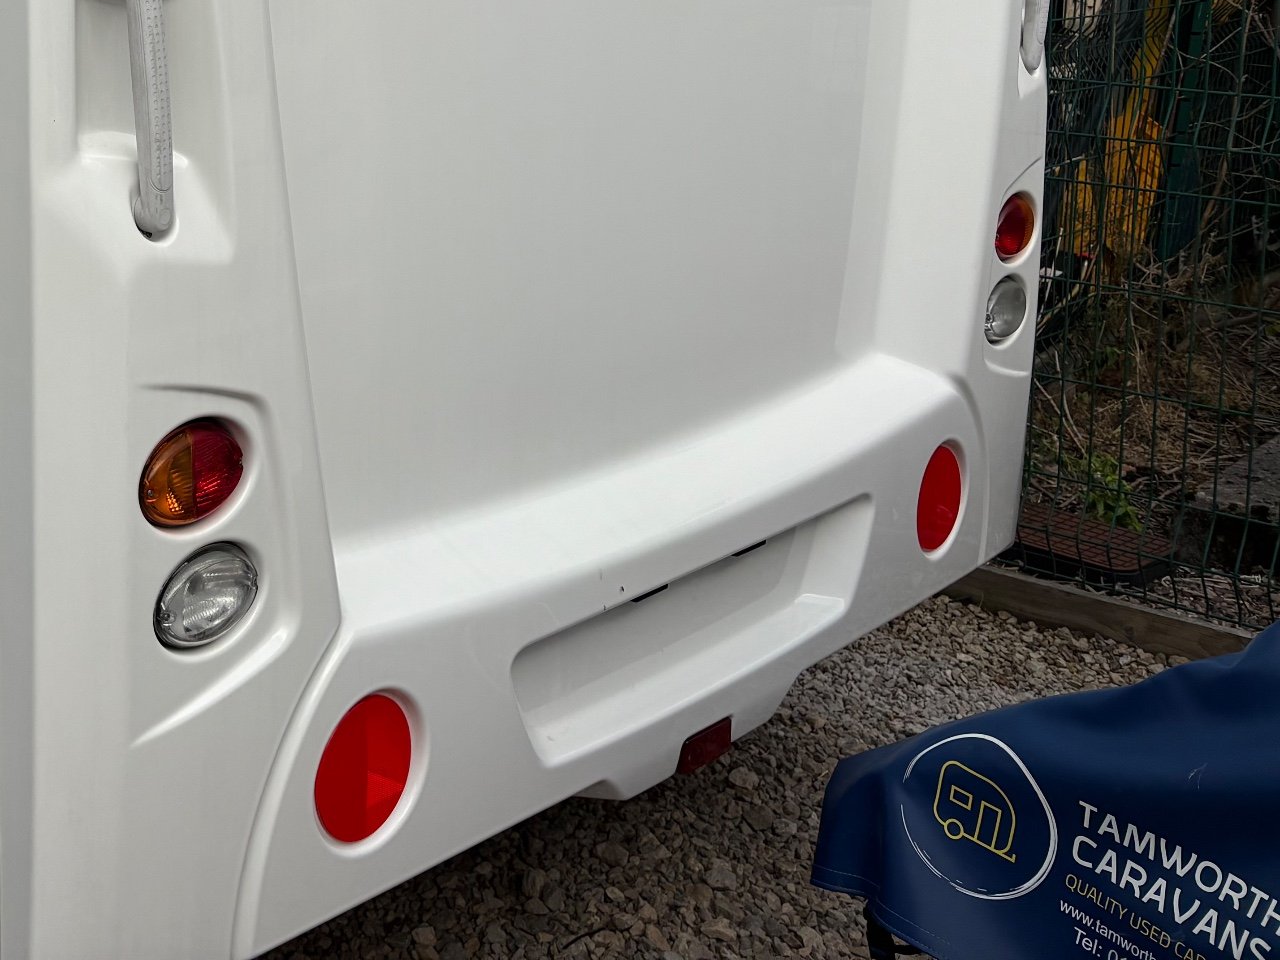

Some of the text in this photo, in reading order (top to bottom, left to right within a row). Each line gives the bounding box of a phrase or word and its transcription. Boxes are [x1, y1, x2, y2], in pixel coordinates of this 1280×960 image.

[1078, 800, 1280, 936] TAMWORTH
[1065, 874, 1128, 920] QUALITY
[1129, 913, 1171, 948] USED
[1074, 927, 1103, 957] Tel:
